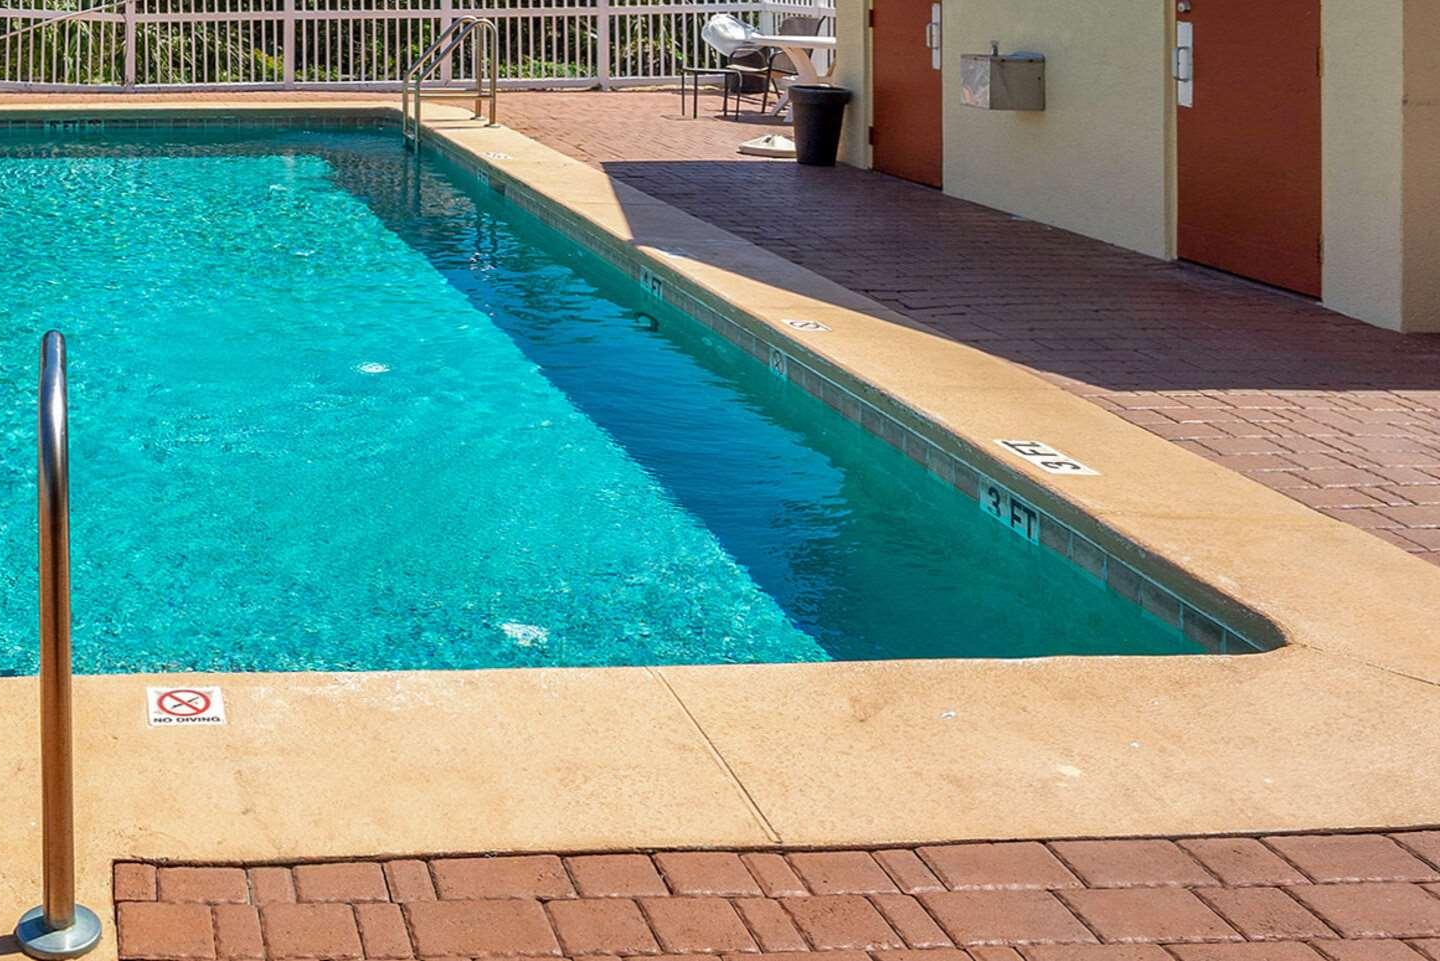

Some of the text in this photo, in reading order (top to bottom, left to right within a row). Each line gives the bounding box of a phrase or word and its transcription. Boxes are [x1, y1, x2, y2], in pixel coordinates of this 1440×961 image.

[987, 485, 1001, 518] 3
[153, 716, 221, 724] NO DIVING
